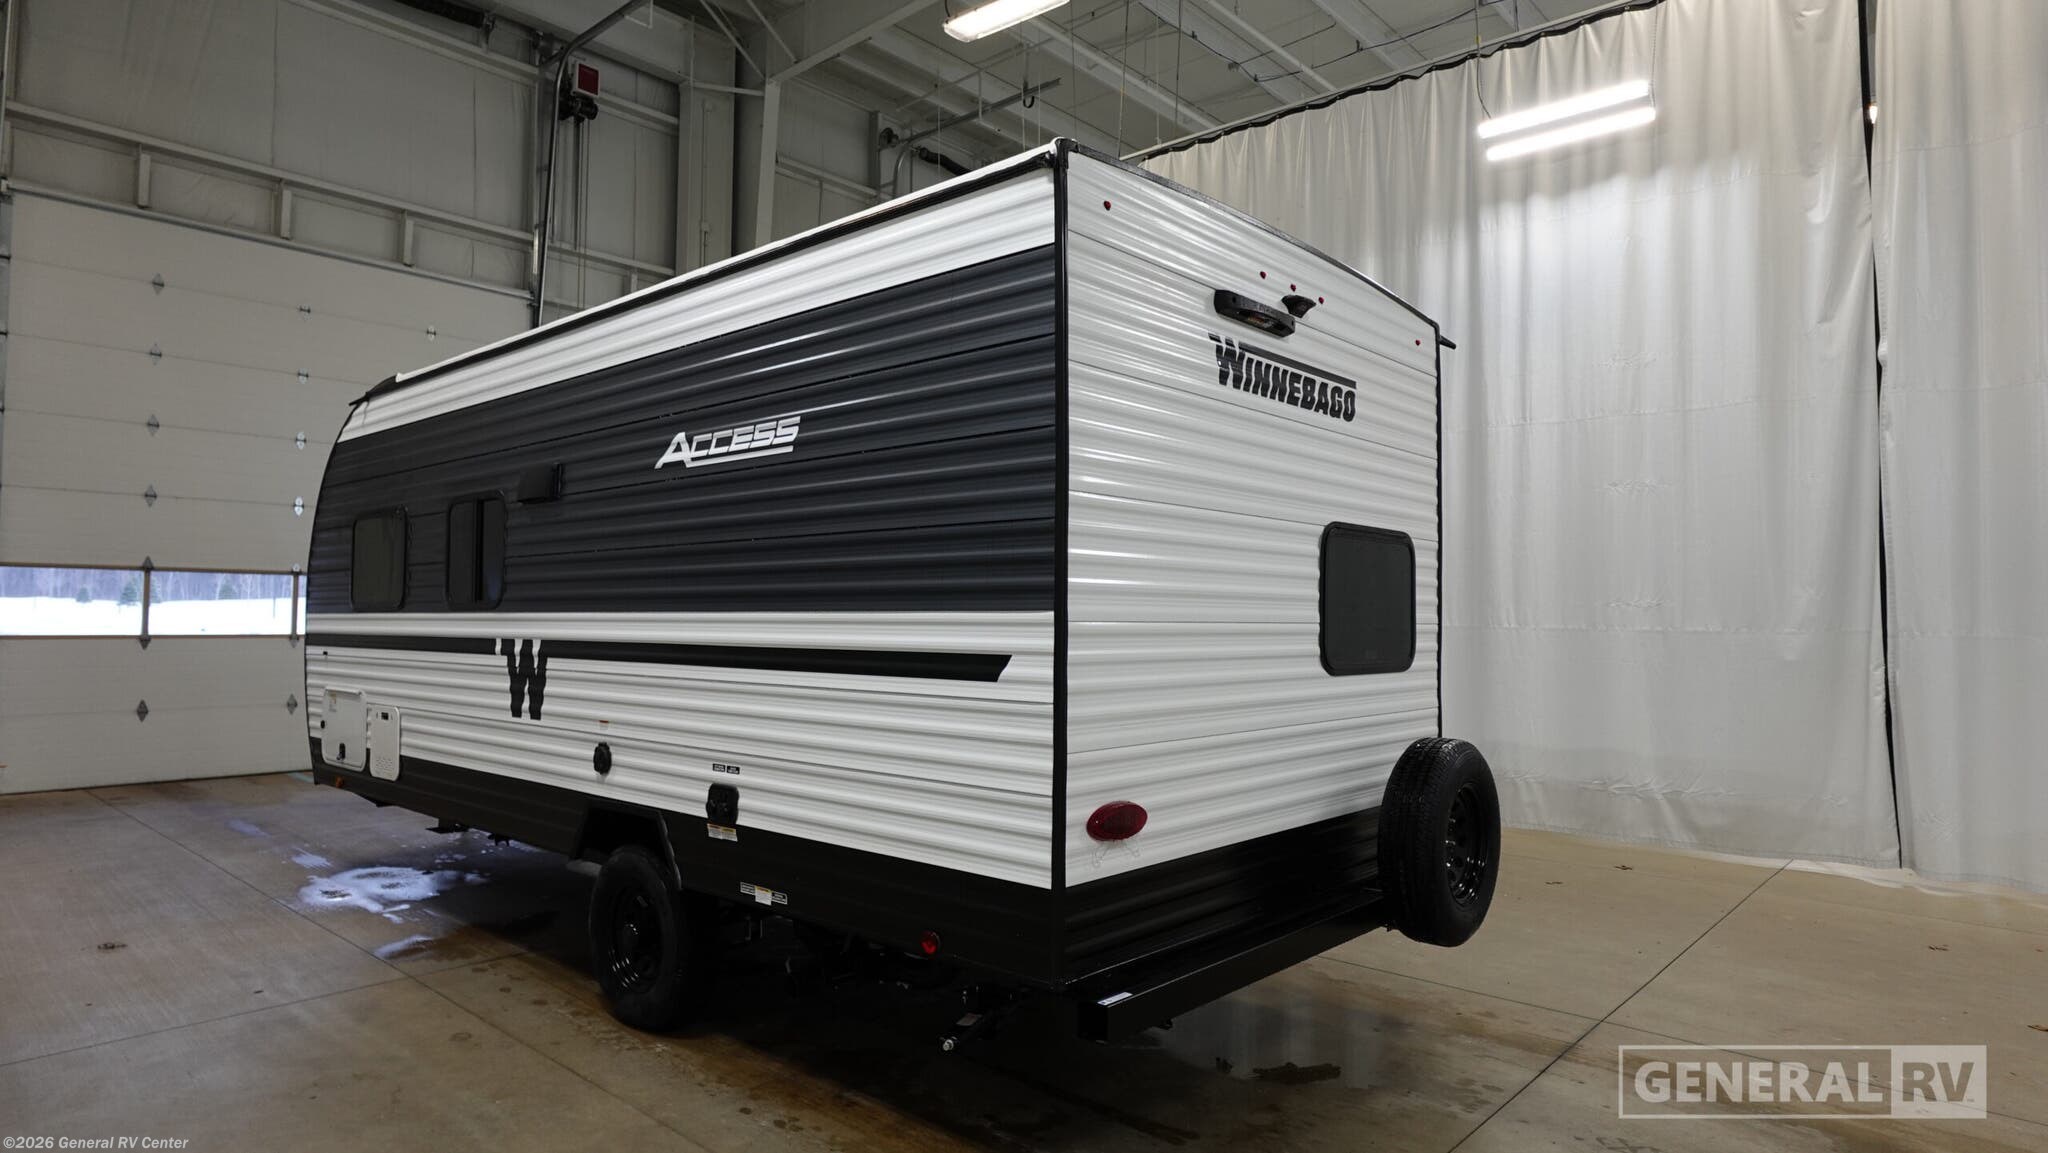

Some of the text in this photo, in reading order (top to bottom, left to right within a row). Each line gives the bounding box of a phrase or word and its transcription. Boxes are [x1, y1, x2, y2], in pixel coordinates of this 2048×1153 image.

[1208, 333, 1357, 422] WINNEBAGO
[654, 416, 801, 469] ACCESS
[498, 638, 548, 720] W
